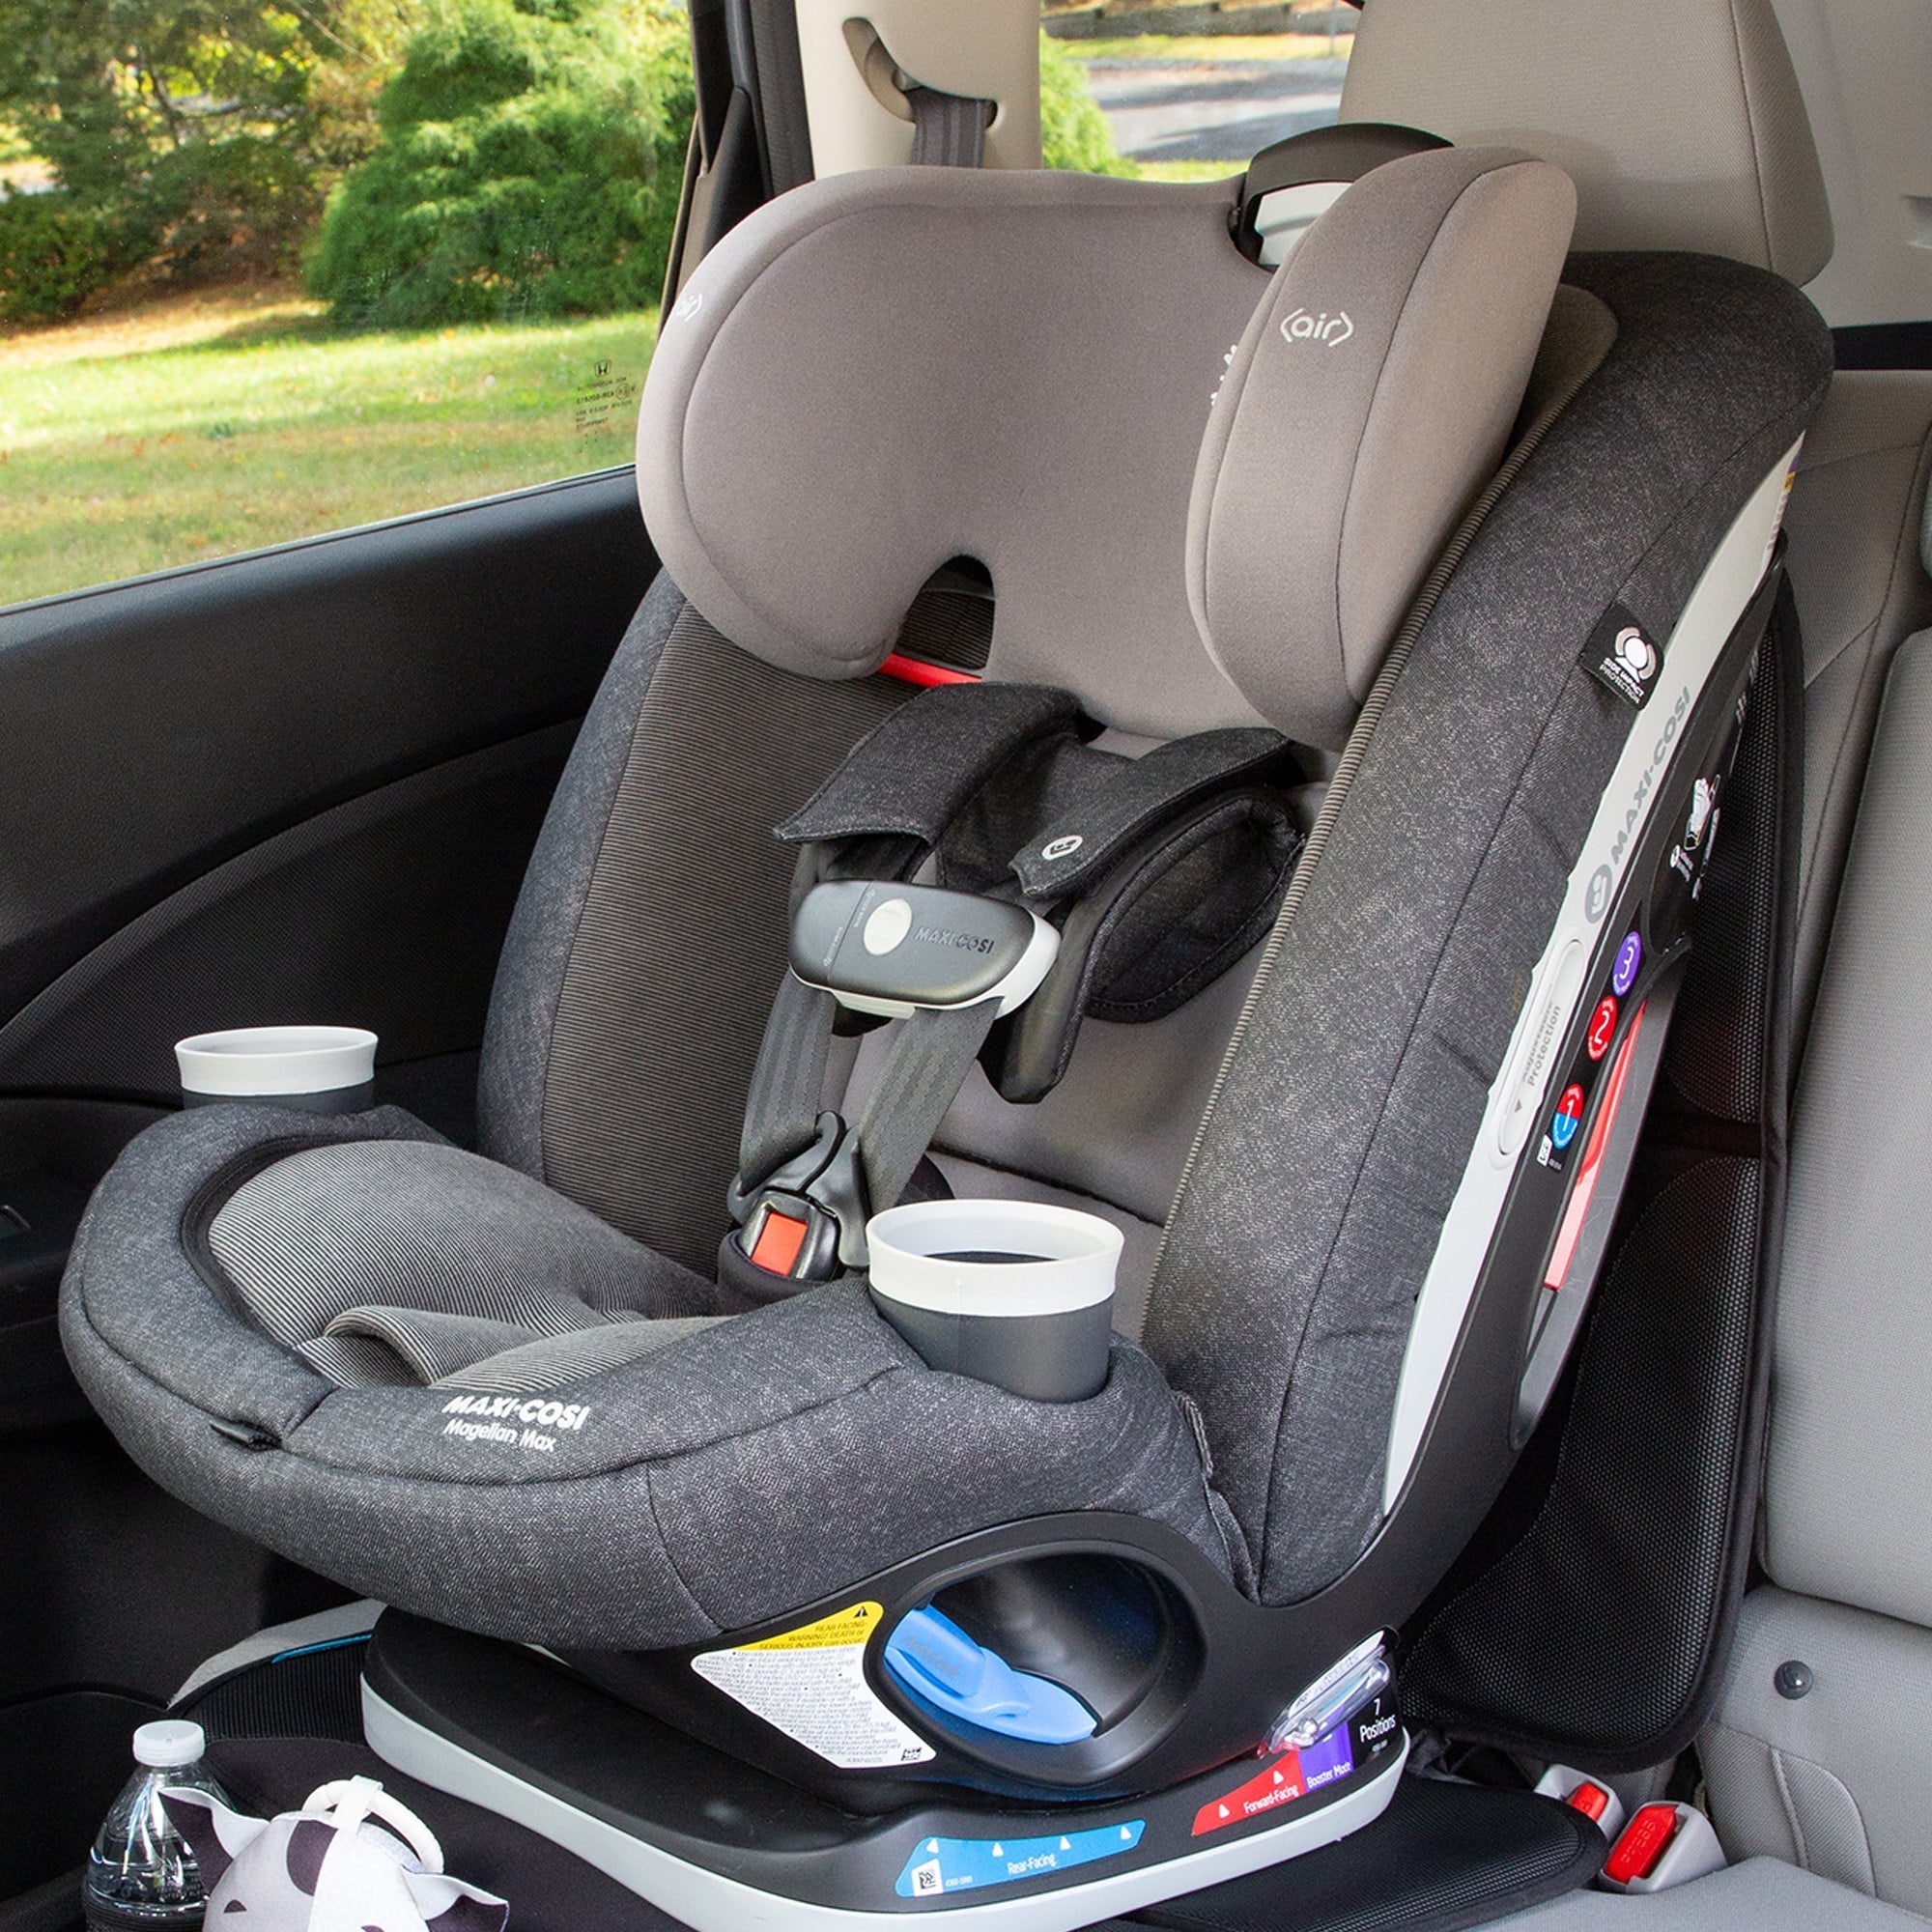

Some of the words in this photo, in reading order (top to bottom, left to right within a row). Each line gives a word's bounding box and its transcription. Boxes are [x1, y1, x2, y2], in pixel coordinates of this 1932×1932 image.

[1599, 664, 1640, 704] PROTECTION
[1620, 946, 1634, 980] 3
[1594, 1010, 1610, 1044] 2
[1527, 1006, 1561, 1087] Protection
[1563, 1099, 1575, 1131] 1
[442, 1418, 519, 1443] Magellan
[519, 1428, 556, 1452] Max
[1374, 1697, 1381, 1716] 7
[1359, 1714, 1396, 1743] Positions
[1306, 1769, 1333, 1789] Booster
[1333, 1762, 1351, 1777] Mode
[1243, 1784, 1301, 1814] Forward-Facing
[1008, 1853, 1058, 1876] Rear-Facing
